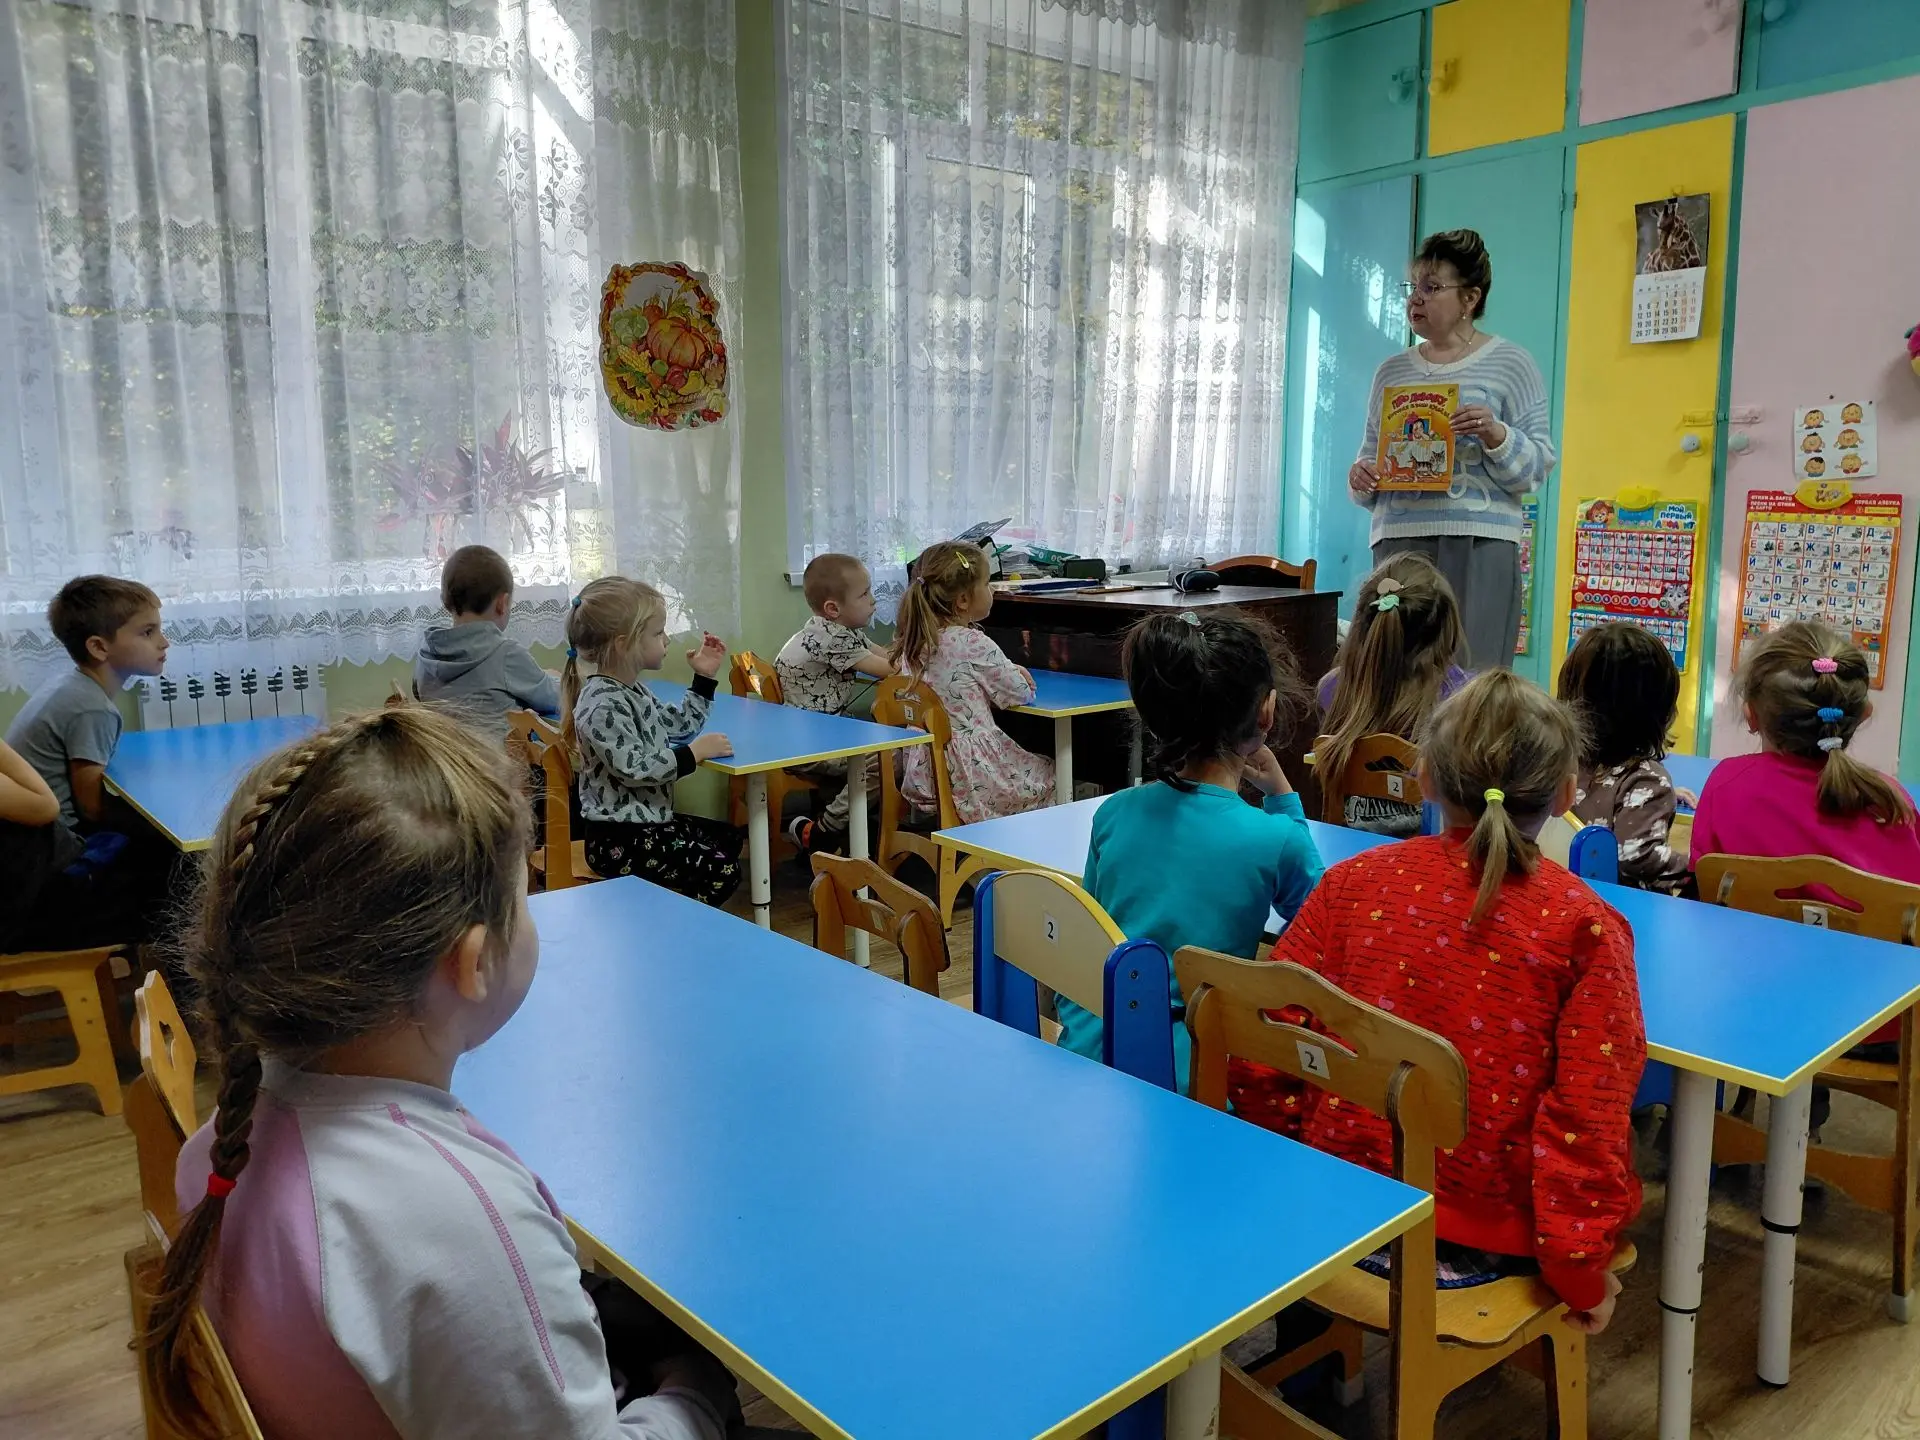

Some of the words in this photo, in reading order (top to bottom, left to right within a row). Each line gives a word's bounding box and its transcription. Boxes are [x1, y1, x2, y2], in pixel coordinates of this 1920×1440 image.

[1780, 524, 1787, 532] Б
[1808, 525, 1815, 533] В
[1837, 526, 1843, 534] Г
[1866, 528, 1874, 537] Д
[1750, 540, 1756, 548] Е
[1778, 541, 1784, 550] Ё
[1806, 543, 1815, 551] Ж
[1864, 546, 1871, 554] И
[1749, 557, 1756, 566] Й
[1776, 559, 1783, 567] К
[1805, 560, 1812, 568] Л
[1833, 562, 1841, 570] М
[1863, 564, 1870, 572] Н
[1775, 576, 1781, 584] П
[1803, 577, 1809, 586] Р
[1831, 579, 1838, 588] С
[1861, 582, 1867, 590] Т
[1746, 590, 1752, 599] У
[1773, 593, 1781, 601] Ф
[1801, 595, 1808, 603] Х
[1829, 597, 1837, 606] Ц
[1859, 598, 1865, 607] Ч
[1744, 607, 1753, 616] Ш
[1856, 617, 1862, 625] Ь
[860, 773, 865, 782] 2
[1393, 782, 1400, 792] 2
[760, 792, 766, 802] 2
[1812, 912, 1822, 926] 2
[1047, 921, 1054, 939] 2
[1305, 1051, 1318, 1071] 2
